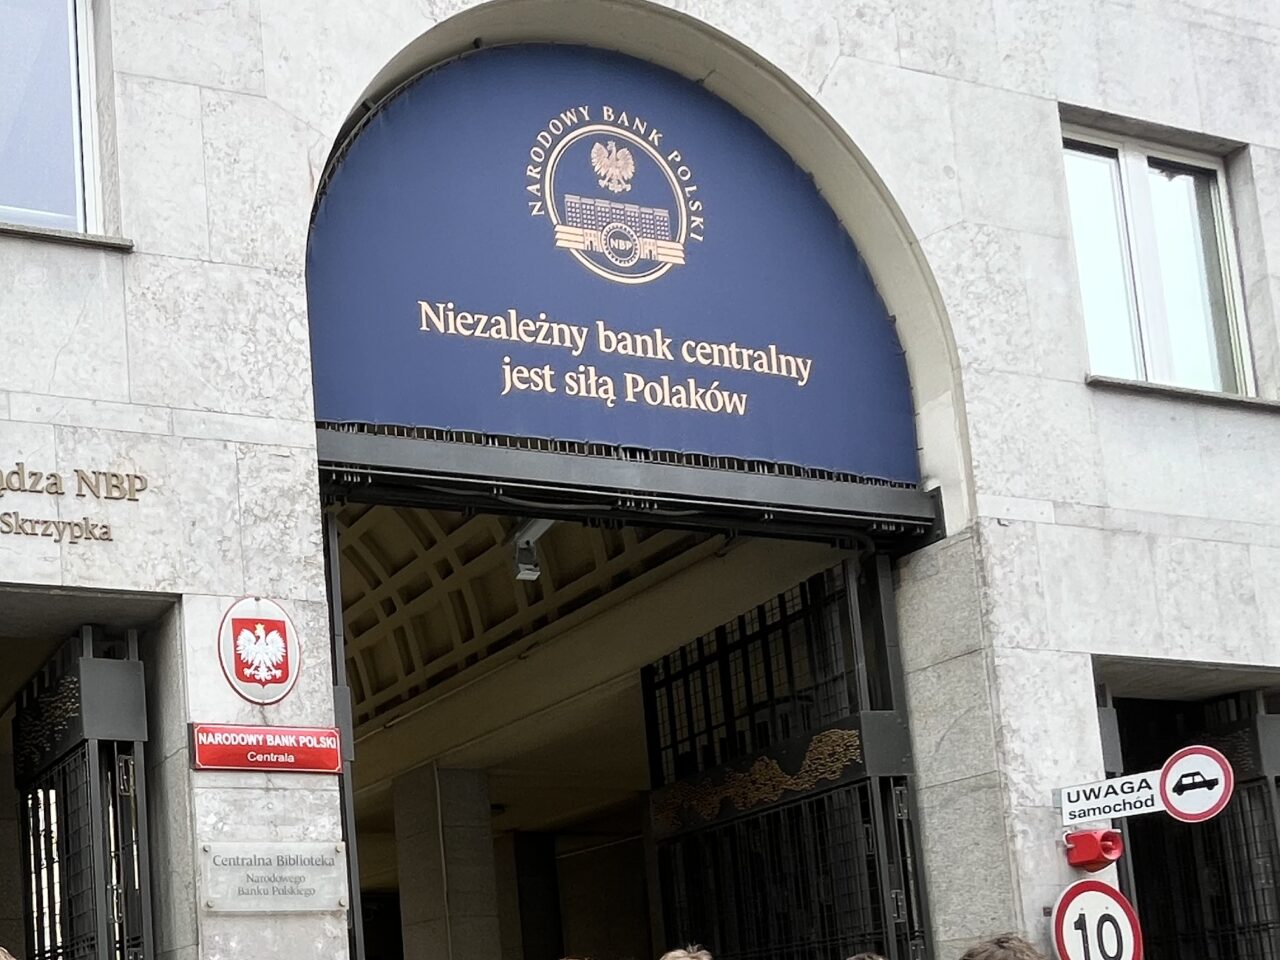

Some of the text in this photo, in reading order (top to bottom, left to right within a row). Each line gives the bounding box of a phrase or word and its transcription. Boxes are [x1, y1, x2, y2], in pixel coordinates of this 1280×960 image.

[525, 105, 704, 243] NARODOWY BANK POLSKI
[609, 238, 633, 251] NBP
[417, 300, 813, 387] Niezależny bank centralny
[500, 355, 748, 416] jest siłą Polaków
[73, 468, 149, 502] NBP
[0, 511, 114, 545] Skrzypka
[198, 732, 337, 749] NARODOWY BANK POLSKI
[246, 751, 295, 763] Centrala
[1066, 777, 1153, 804] UWAGA
[1067, 794, 1156, 821] samochód
[212, 854, 336, 867] Centralna Biblioteka
[237, 886, 316, 897] Banku Polskiego
[245, 873, 306, 886] Narodowego
